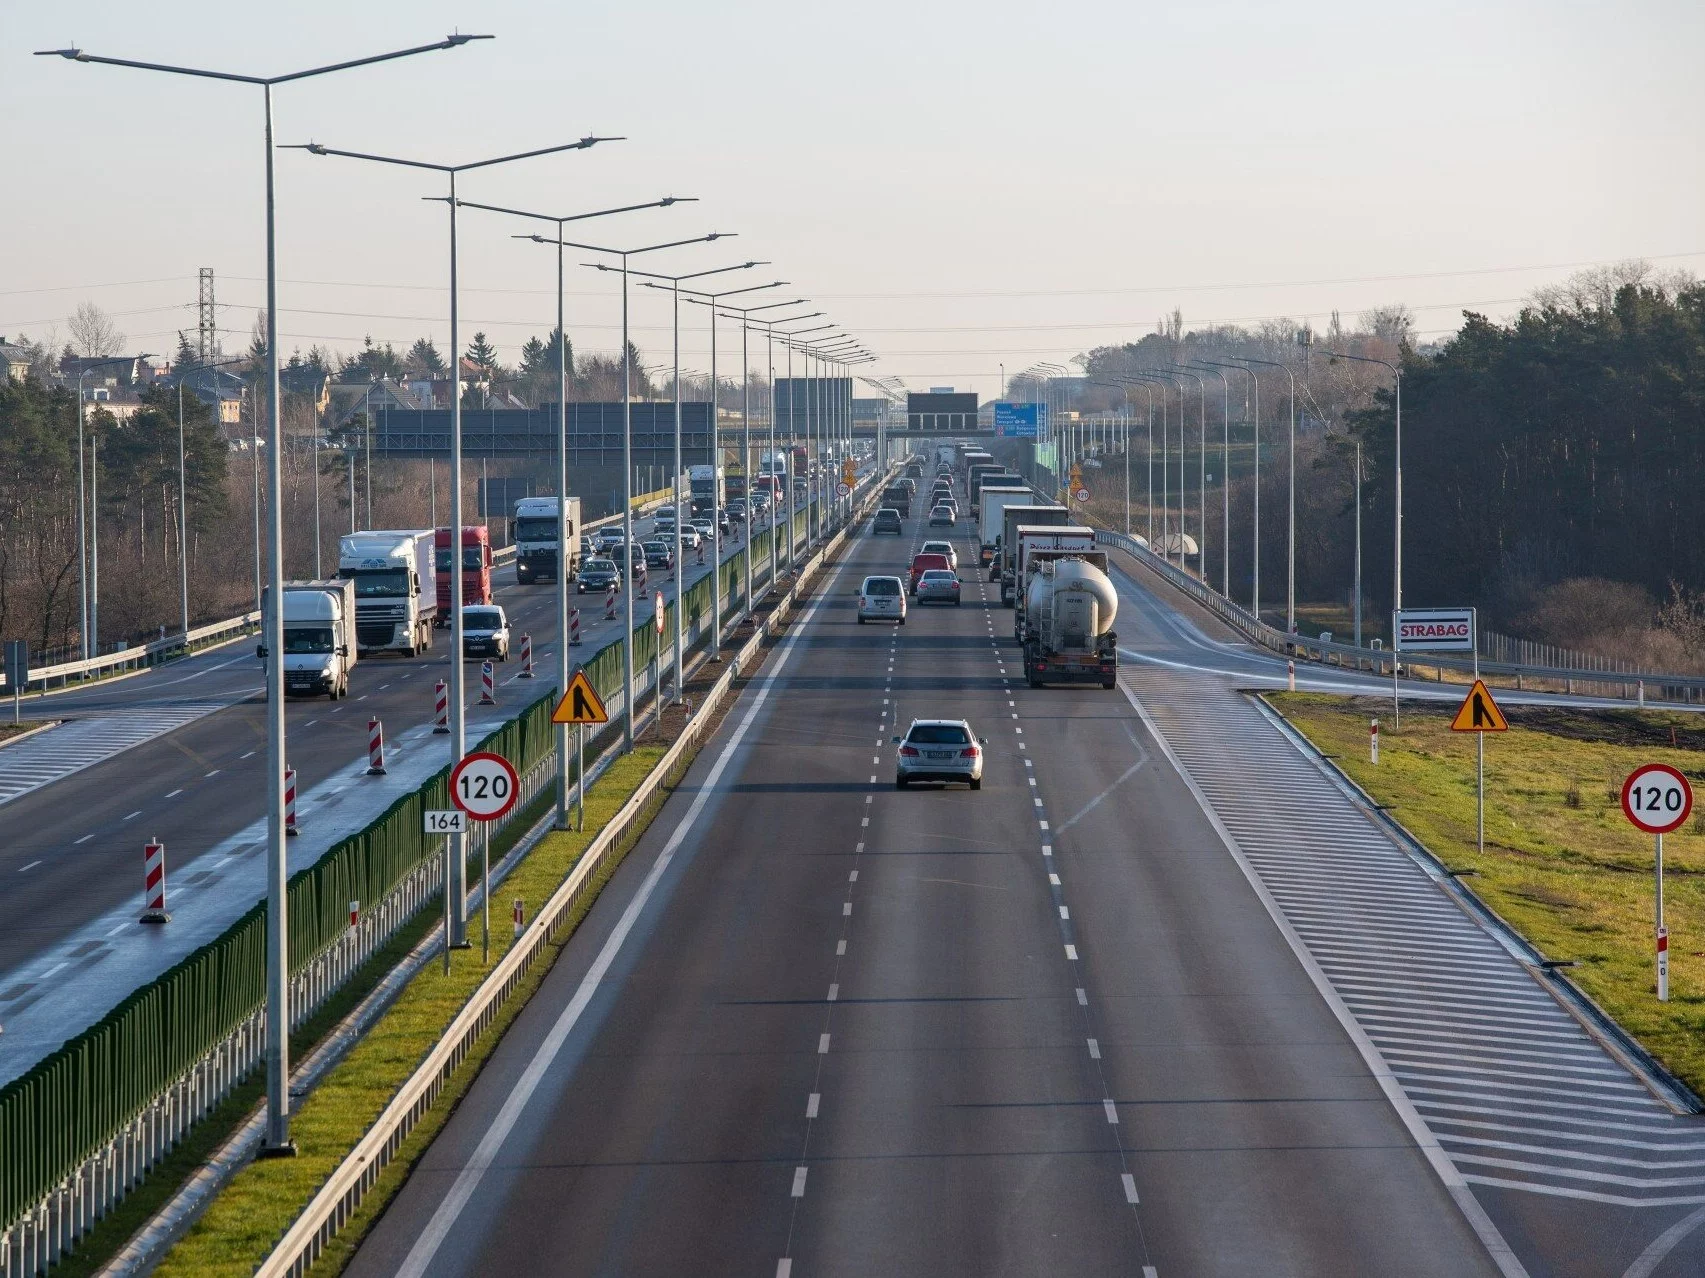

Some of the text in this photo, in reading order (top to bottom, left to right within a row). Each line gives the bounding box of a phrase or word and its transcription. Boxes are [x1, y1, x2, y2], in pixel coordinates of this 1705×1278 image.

[1400, 624, 1469, 637] STRABAG
[460, 775, 508, 799] 120
[1632, 786, 1682, 811] 120
[430, 814, 460, 829] 164
